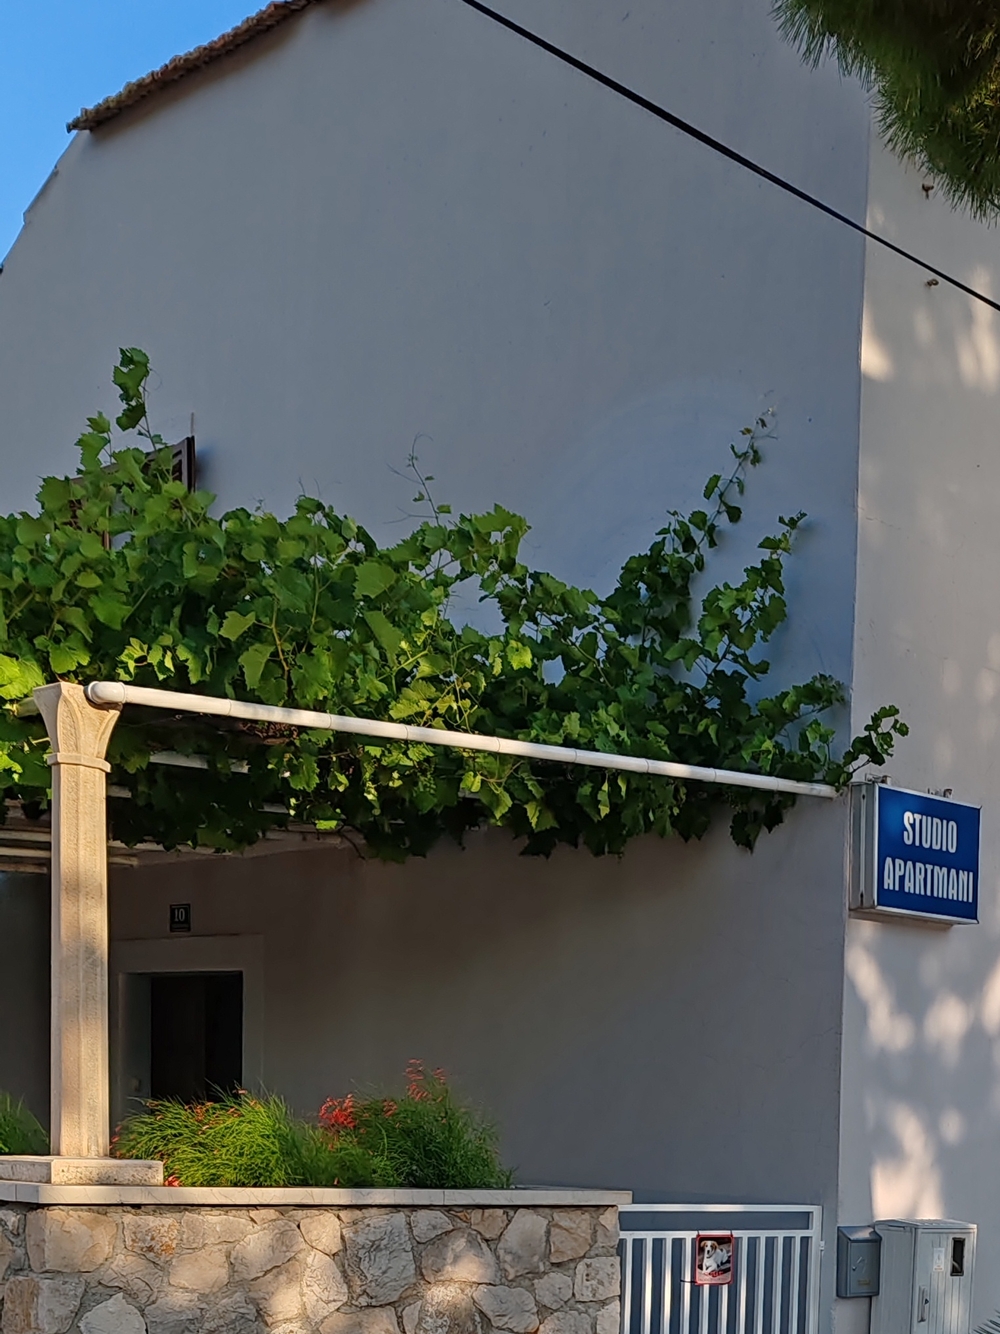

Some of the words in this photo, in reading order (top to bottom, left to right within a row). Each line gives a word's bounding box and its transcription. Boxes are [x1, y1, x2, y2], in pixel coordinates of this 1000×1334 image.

[903, 811, 958, 853] STUDIO
[883, 857, 974, 903] APARTMANI
[174, 908, 186, 922] 10
